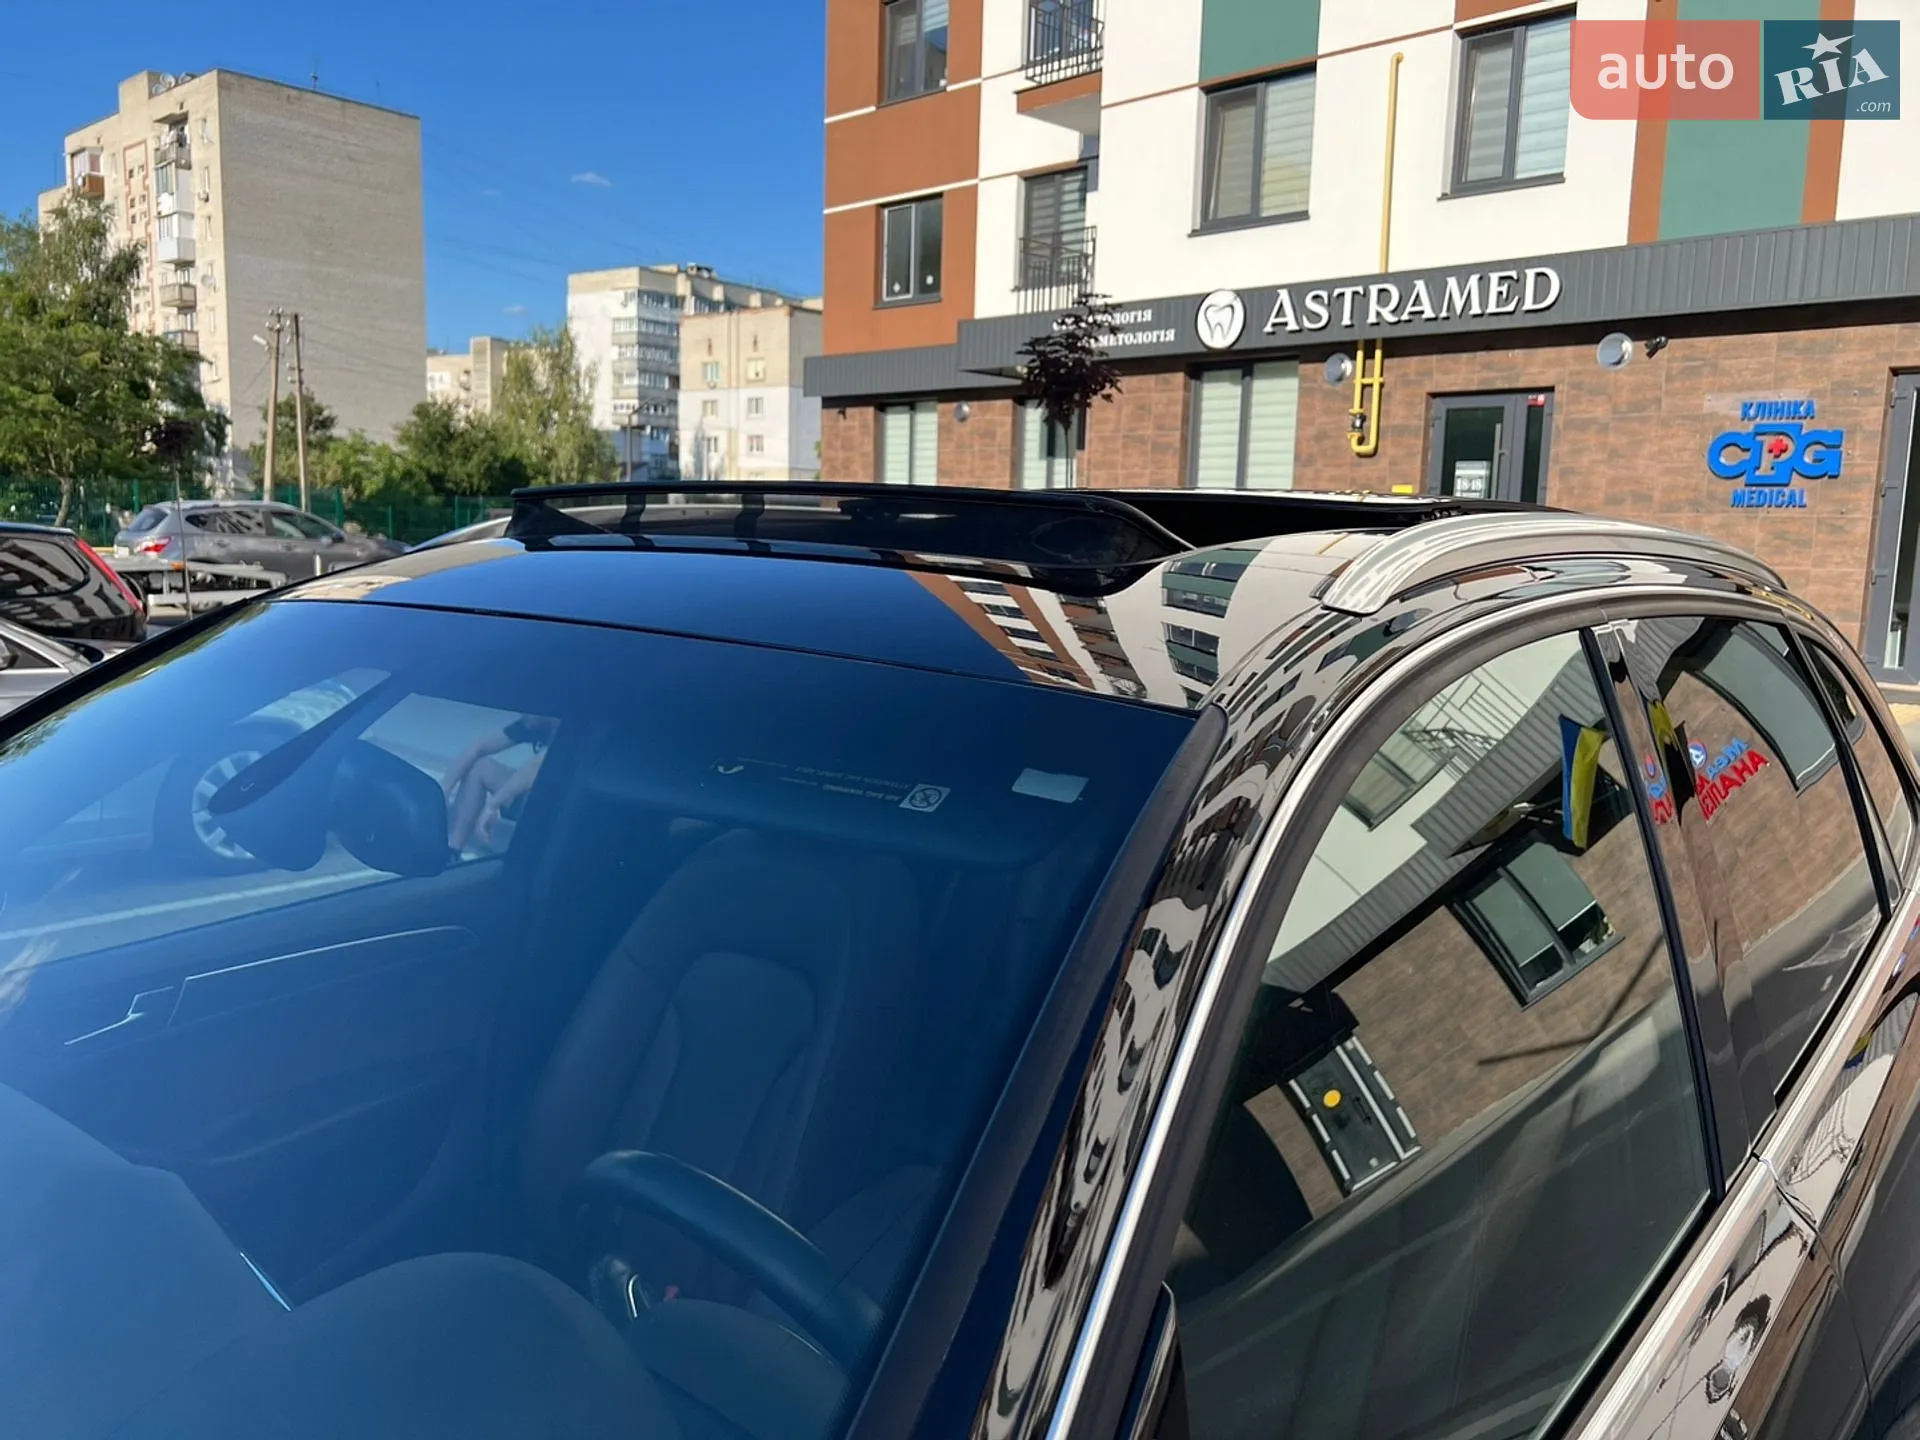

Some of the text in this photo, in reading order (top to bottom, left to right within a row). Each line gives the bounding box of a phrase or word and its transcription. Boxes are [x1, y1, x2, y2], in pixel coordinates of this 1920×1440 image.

[1263, 267, 1561, 333] ASTRAMED
[1740, 400, 1816, 421] КЛІНІКА
[1731, 488, 1807, 508] MEDICAL
